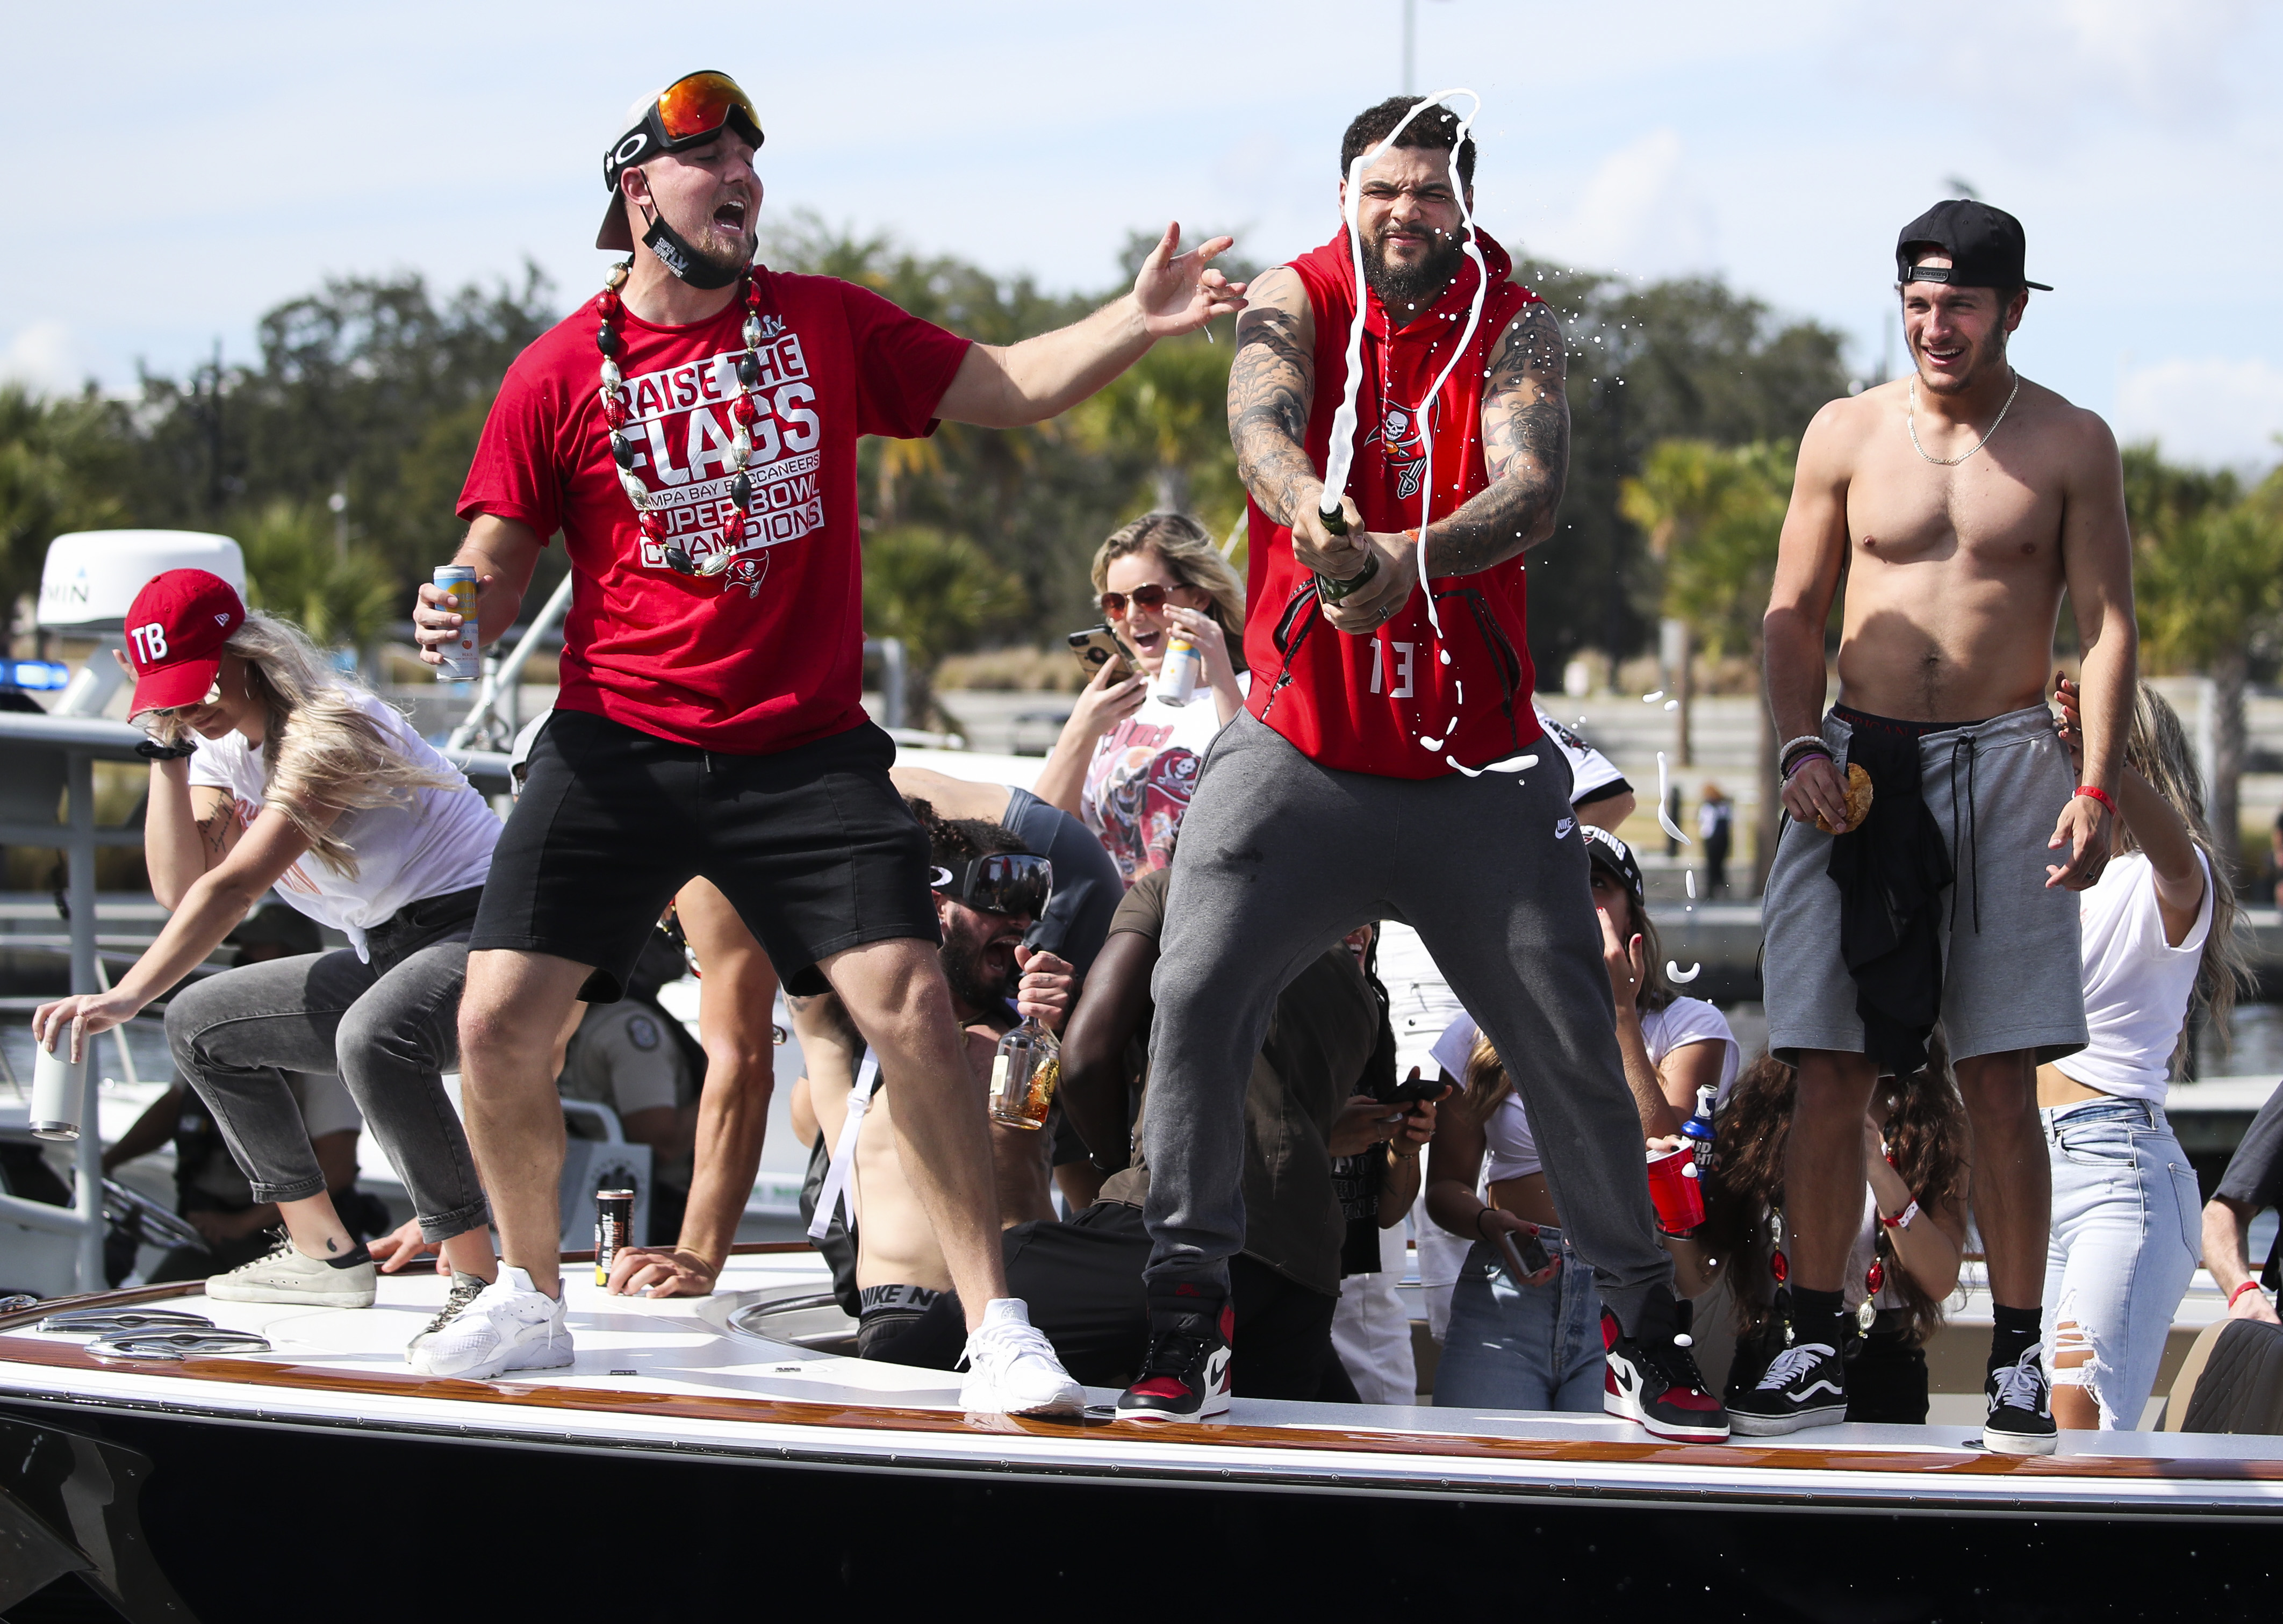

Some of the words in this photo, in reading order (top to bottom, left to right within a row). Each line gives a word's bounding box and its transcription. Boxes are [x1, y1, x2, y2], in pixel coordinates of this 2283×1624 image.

[653, 244, 670, 260] BOWL
[656, 236, 676, 255] SUPER
[688, 482, 718, 501] BAY
[748, 472, 820, 515] BOWL
[131, 622, 169, 664] TB
[1369, 637, 1415, 698] 13
[1557, 817, 1572, 831] NIKE
[860, 1284, 904, 1307] NIKE
